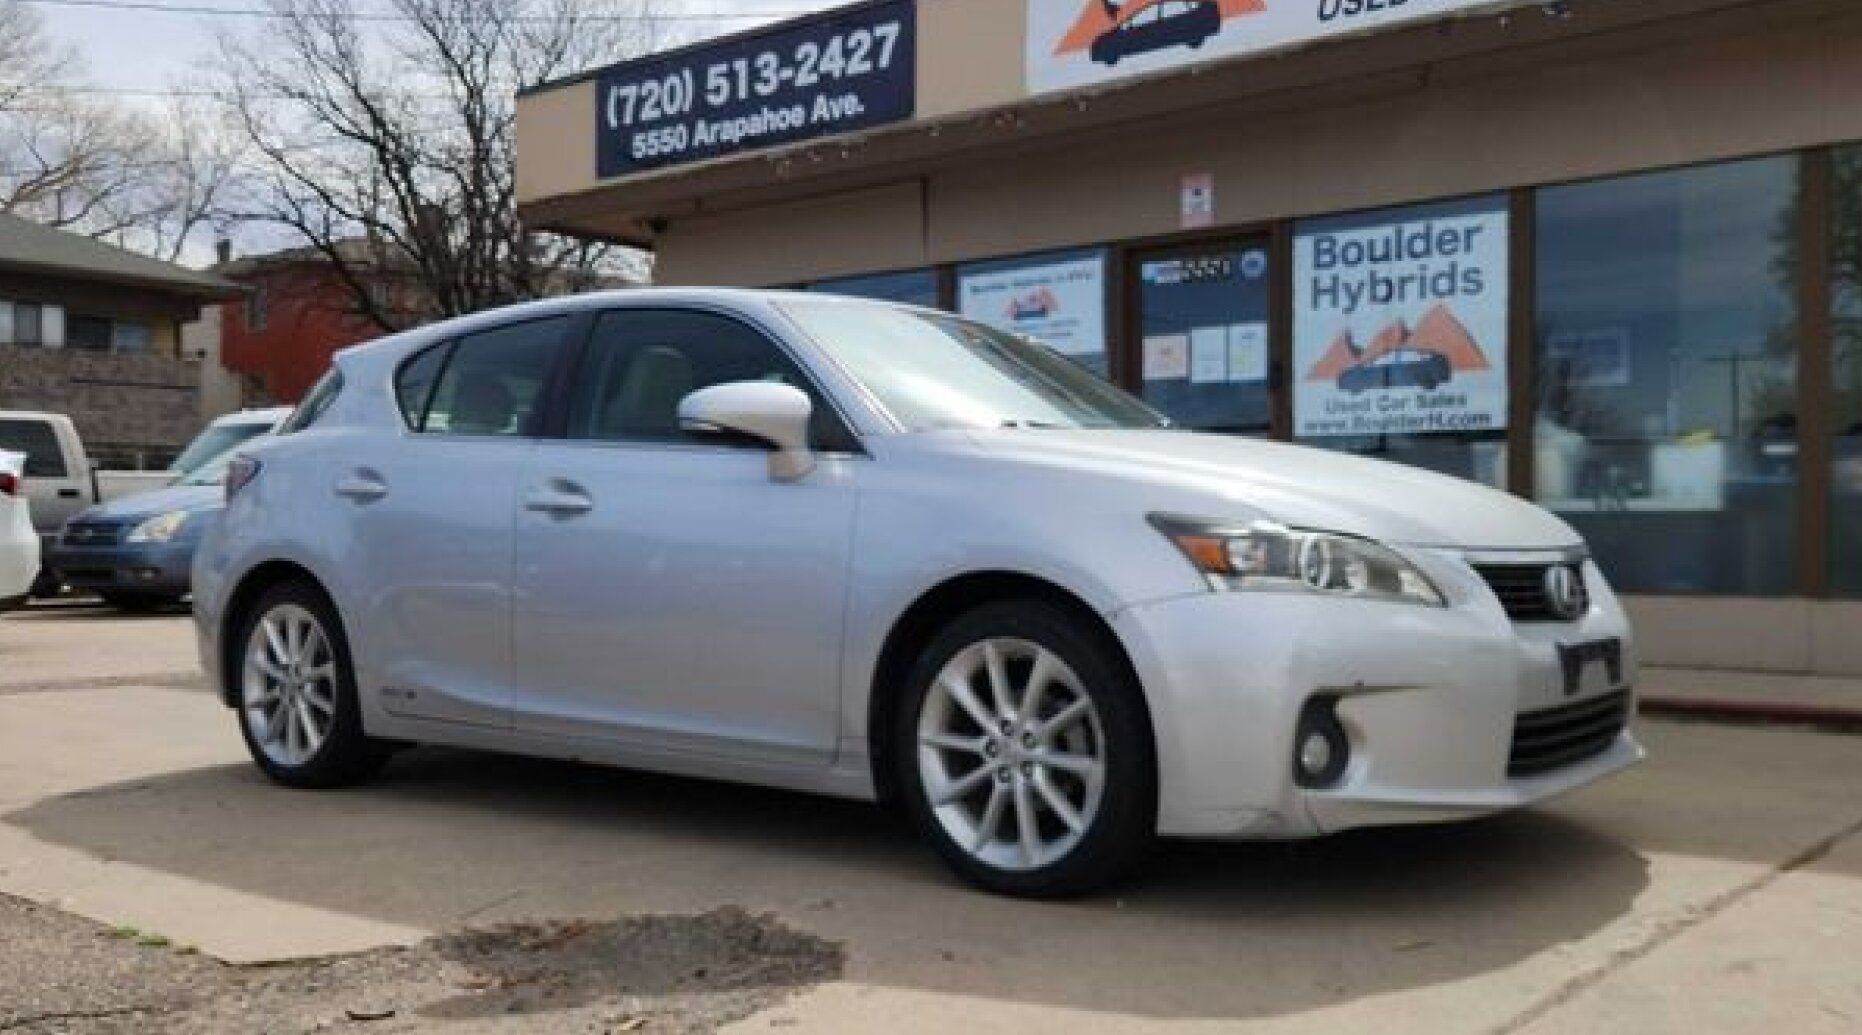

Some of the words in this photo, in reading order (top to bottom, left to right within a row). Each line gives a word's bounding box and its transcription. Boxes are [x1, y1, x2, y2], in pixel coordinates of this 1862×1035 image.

[607, 69, 693, 128] (720)
[706, 22, 899, 105] 513-2427
[632, 124, 688, 158] 5550
[693, 105, 805, 146] Arapahoe
[811, 92, 864, 123] Ave.
[1313, 221, 1482, 270] Boulder
[1311, 261, 1484, 314] Hybrids
